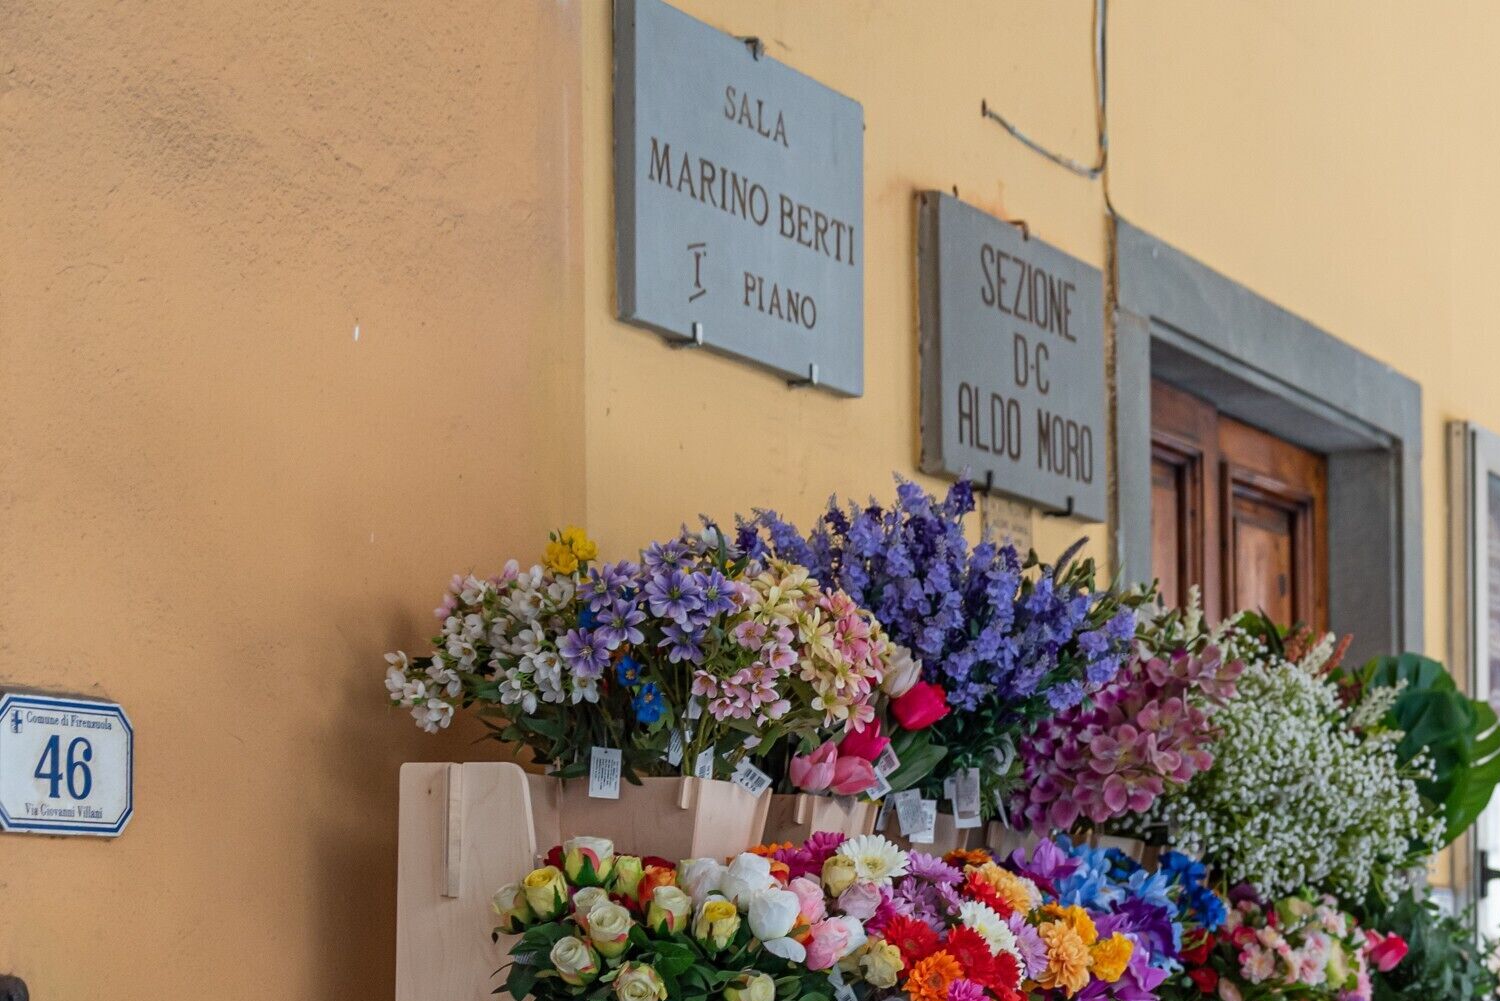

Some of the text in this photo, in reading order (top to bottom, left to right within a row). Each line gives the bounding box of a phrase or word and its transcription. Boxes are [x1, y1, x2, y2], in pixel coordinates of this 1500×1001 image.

[724, 85, 789, 148] SALA
[648, 136, 856, 267] MARINO BERTI
[743, 271, 818, 330] PIANO
[980, 243, 1078, 343] SEZIONE
[957, 381, 1094, 486] ALDO MORO
[26, 710, 112, 731] Comune di Firenzuola
[34, 734, 93, 801] 46
[24, 802, 103, 819] Via Giovanni Villani
